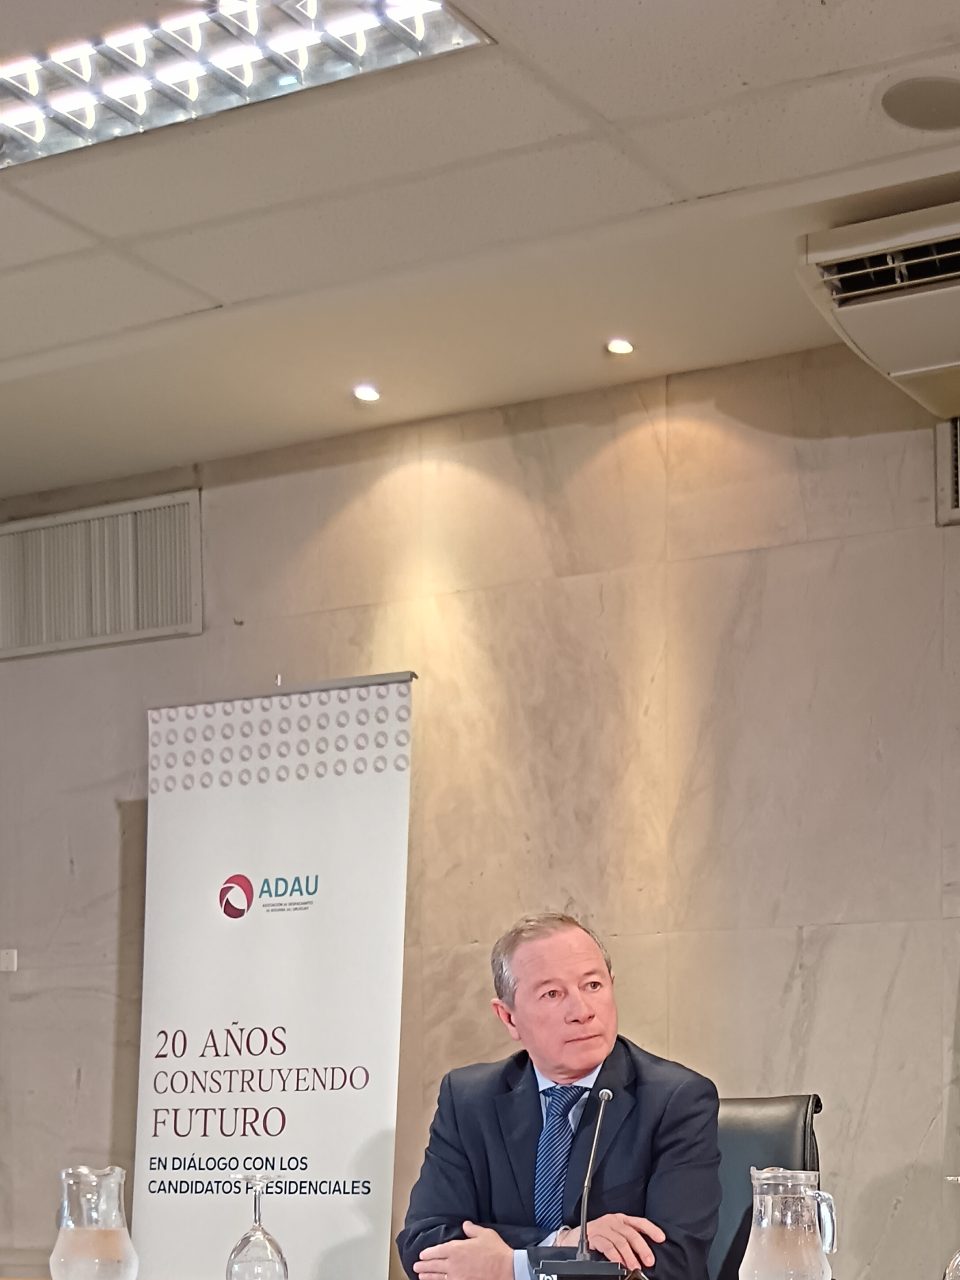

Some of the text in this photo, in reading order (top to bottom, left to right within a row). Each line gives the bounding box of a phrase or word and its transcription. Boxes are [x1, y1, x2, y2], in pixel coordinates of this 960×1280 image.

[258, 874, 319, 899] ADAU
[154, 1021, 287, 1059] 20 AÑOS
[153, 1065, 370, 1095] CONSTRUYENDO
[151, 1106, 287, 1138] FUTURO
[149, 1152, 309, 1171] EN DIÁLOGO CON LOS
[147, 1179, 372, 1196] CANDIDATOS PESIDENCIALES
